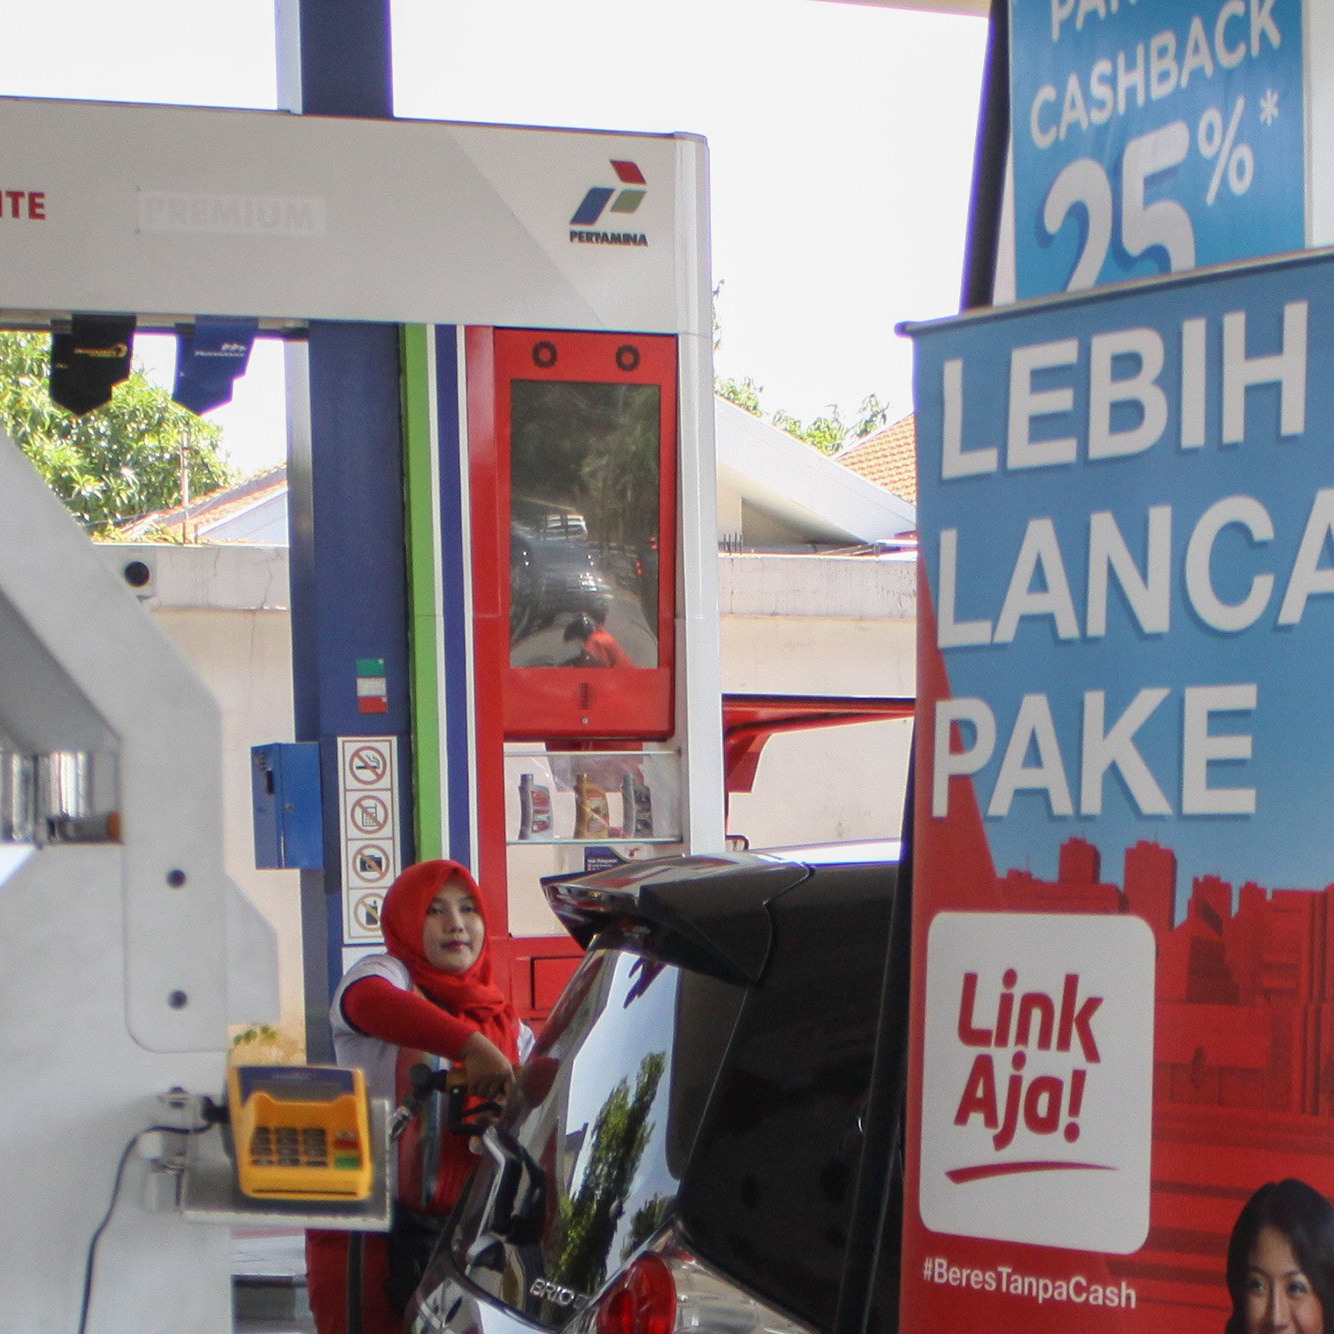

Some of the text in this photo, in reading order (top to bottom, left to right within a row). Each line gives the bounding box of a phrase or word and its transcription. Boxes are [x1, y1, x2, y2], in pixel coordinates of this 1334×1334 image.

[1029, 0, 1281, 149] CASHBACK
[569, 230, 648, 247] PERTAMINA
[940, 301, 1308, 480] LEBIH
[932, 684, 1258, 818] PAKE
[956, 968, 1104, 1064] Link
[953, 1046, 1087, 1152] Aja!
[530, 1278, 575, 1305] BRIO
[922, 1256, 1138, 1310] #BeresTanpaCash
